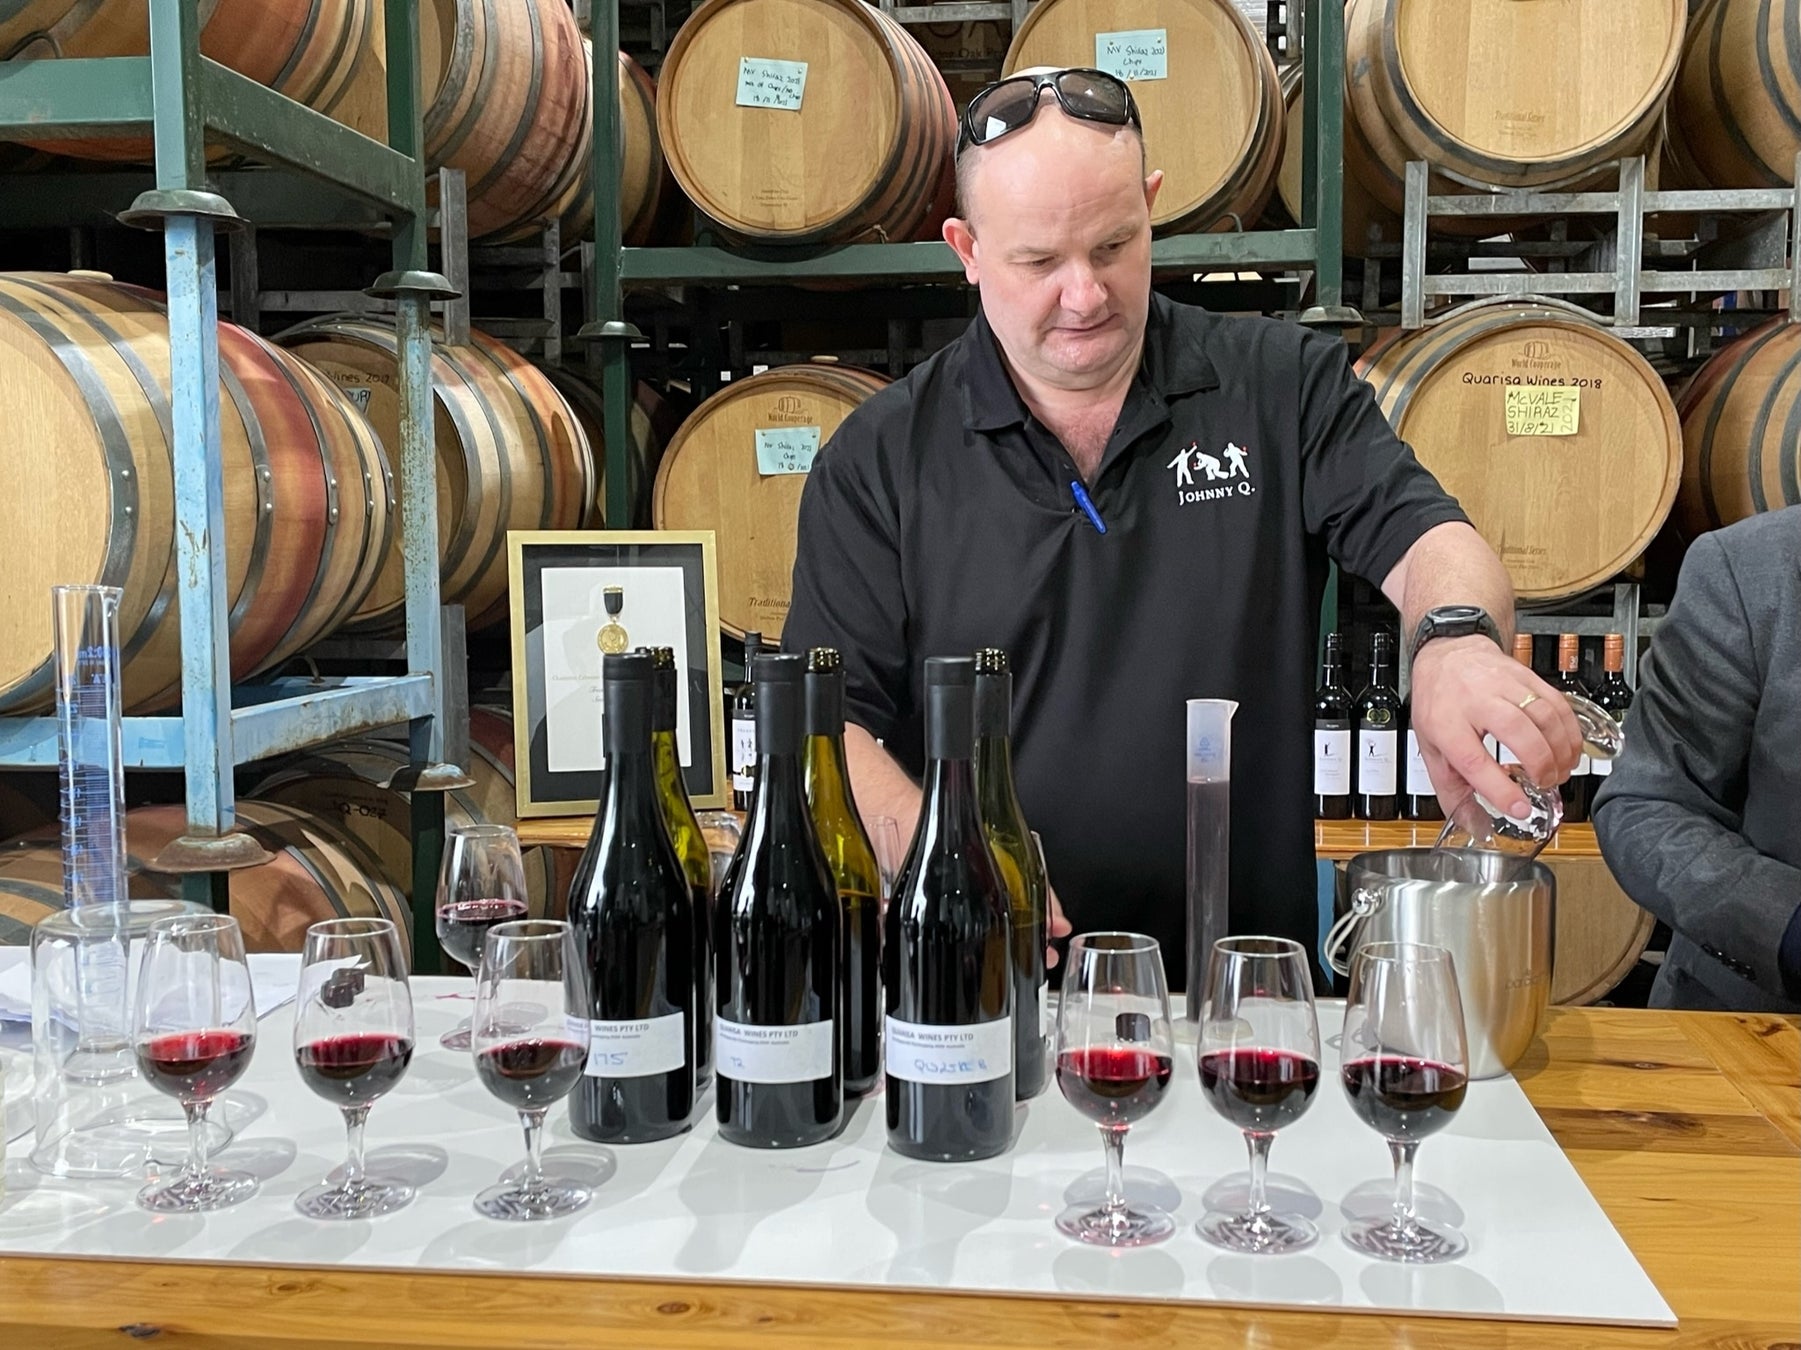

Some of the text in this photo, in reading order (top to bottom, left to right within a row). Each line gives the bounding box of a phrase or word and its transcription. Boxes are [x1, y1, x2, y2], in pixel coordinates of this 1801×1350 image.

[1462, 372, 1603, 389] Quarisa Wines 2018
[1507, 406, 1560, 419] SHIRAZ
[749, 597, 791, 608] Traditiona
[594, 1024, 618, 1032] WINES
[620, 1024, 634, 1033] PTY
[635, 1023, 649, 1031] LTD
[744, 1029, 768, 1038] WINES
[769, 1030, 782, 1039] PTY
[784, 1030, 799, 1038] LTD
[918, 1033, 943, 1041] WINES
[960, 1033, 974, 1041] LTD
